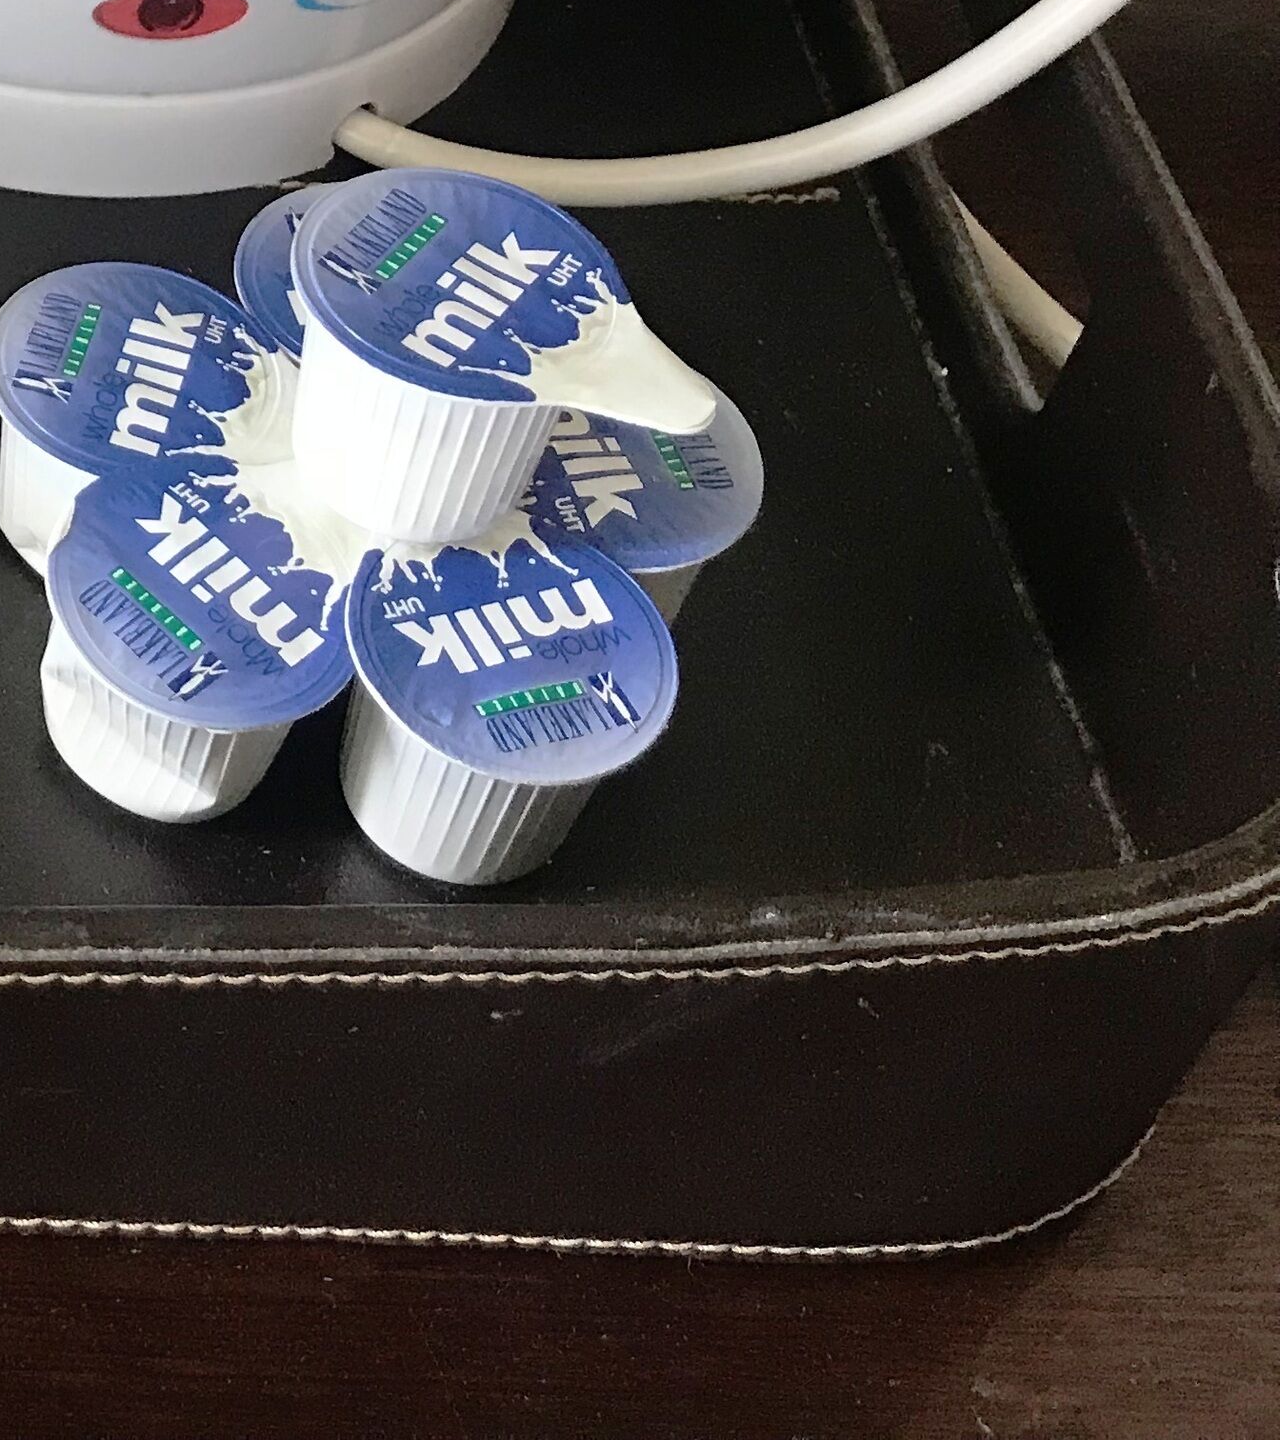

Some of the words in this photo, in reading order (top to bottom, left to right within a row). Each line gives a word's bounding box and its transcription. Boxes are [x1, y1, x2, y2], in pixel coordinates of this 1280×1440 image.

[331, 188, 427, 268] LAKELAND
[401, 231, 561, 368] milk
[546, 253, 583, 287] UHT
[18, 292, 82, 372] LAKELAND
[203, 315, 228, 345] UHT
[109, 301, 204, 457] milk
[168, 482, 211, 513] UHT
[554, 495, 586, 533] UHT
[135, 492, 326, 667] milk
[382, 596, 426, 619] UHT
[78, 578, 192, 680] LAKELAND
[392, 577, 614, 674] milk
[486, 697, 612, 754] LAKELAND
